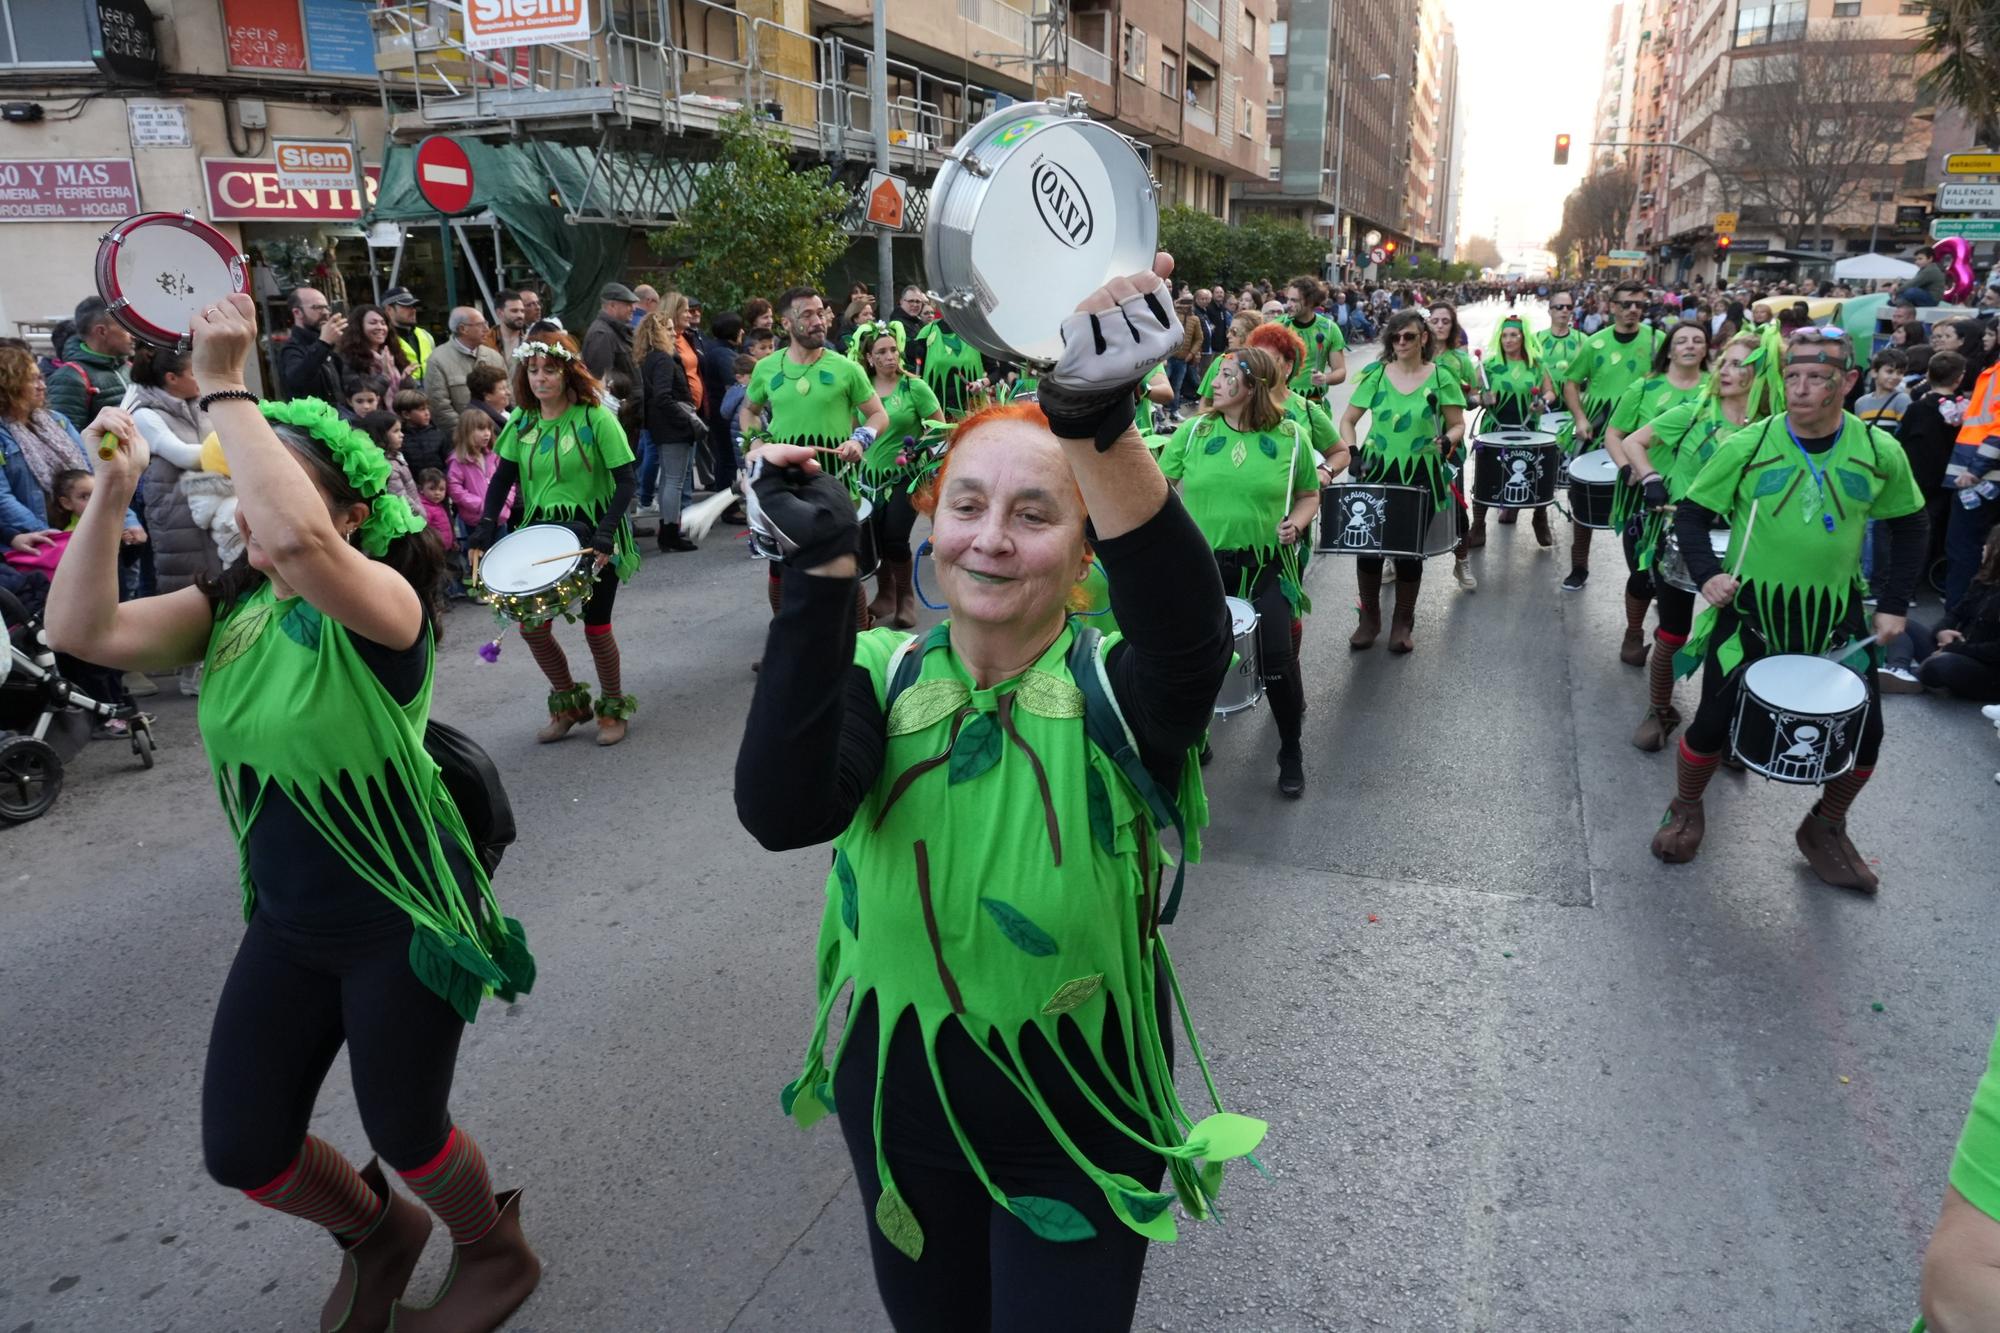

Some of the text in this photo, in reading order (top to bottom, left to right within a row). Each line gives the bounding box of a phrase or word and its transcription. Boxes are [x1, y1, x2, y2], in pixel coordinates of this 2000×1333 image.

[475, 0, 574, 20] Siem
[282, 148, 348, 168] Siem
[27, 165, 45, 186] Y
[54, 164, 110, 186] MAS
[0, 187, 40, 200] MERIA
[55, 186, 132, 199] FERRETERIA
[0, 204, 66, 216] ROGUERIA
[81, 203, 128, 215] HOGAR
